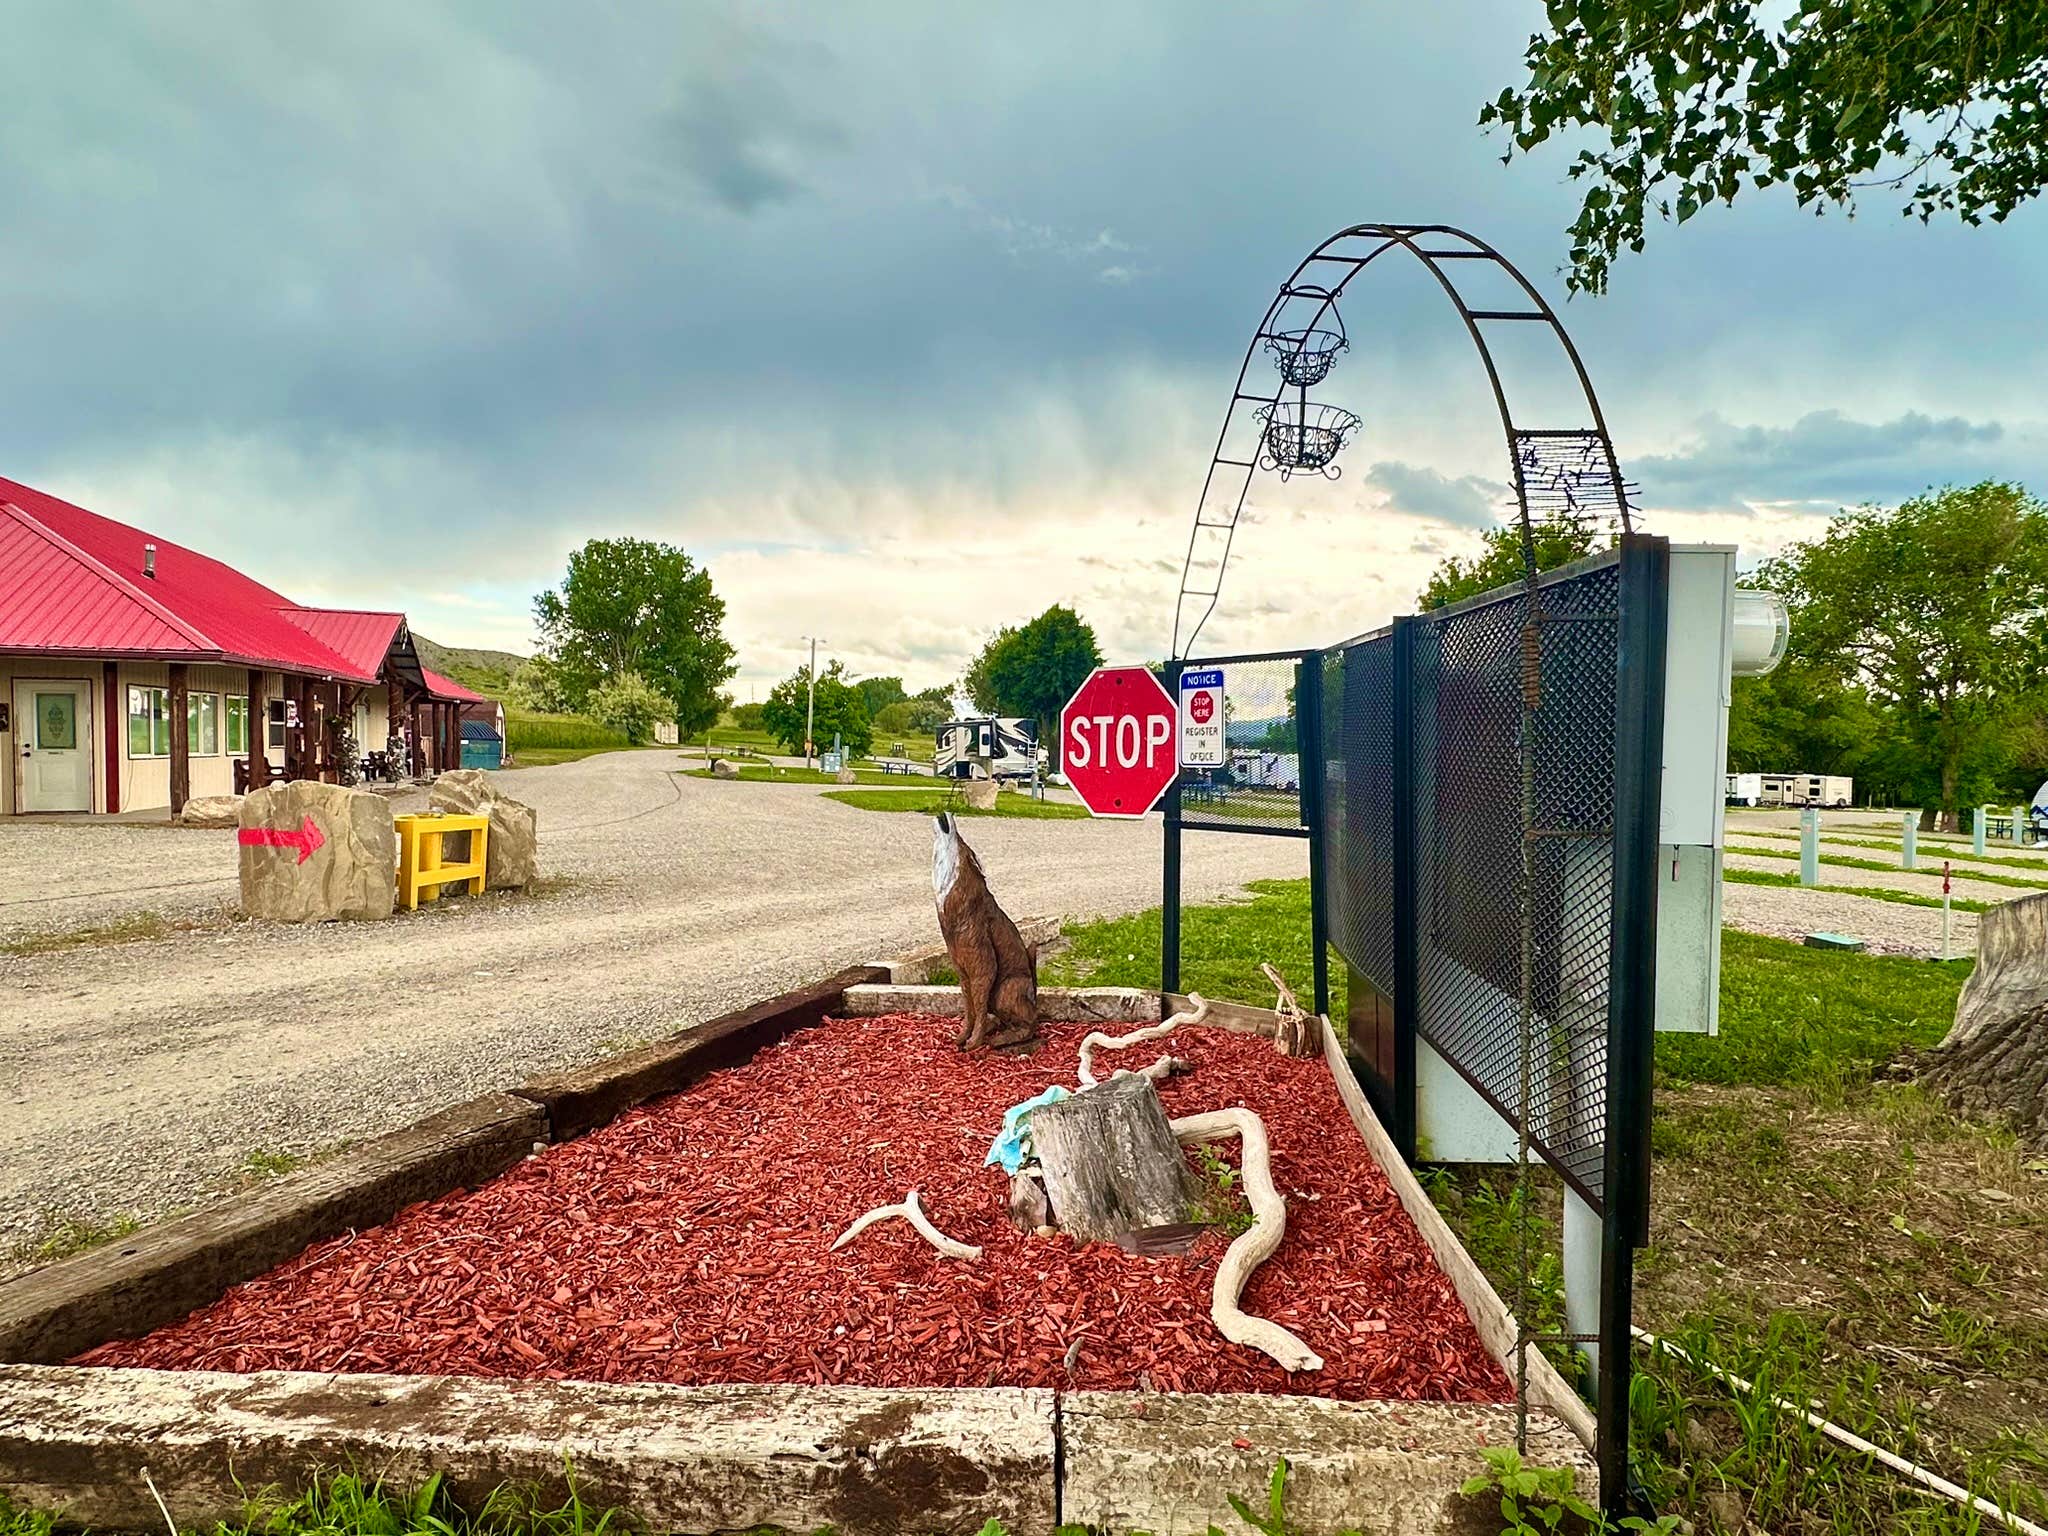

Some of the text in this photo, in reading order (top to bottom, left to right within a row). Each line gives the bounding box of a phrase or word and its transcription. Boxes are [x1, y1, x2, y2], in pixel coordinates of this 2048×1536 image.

[1187, 675, 1217, 686] NOTICE
[1194, 697, 1210, 707] STOP
[1194, 709, 1210, 718] HERE
[1186, 727, 1218, 736] REGISTER
[1068, 714, 1171, 769] STOP
[1198, 740, 1206, 748] IN
[1190, 752, 1214, 762] OFFICE
